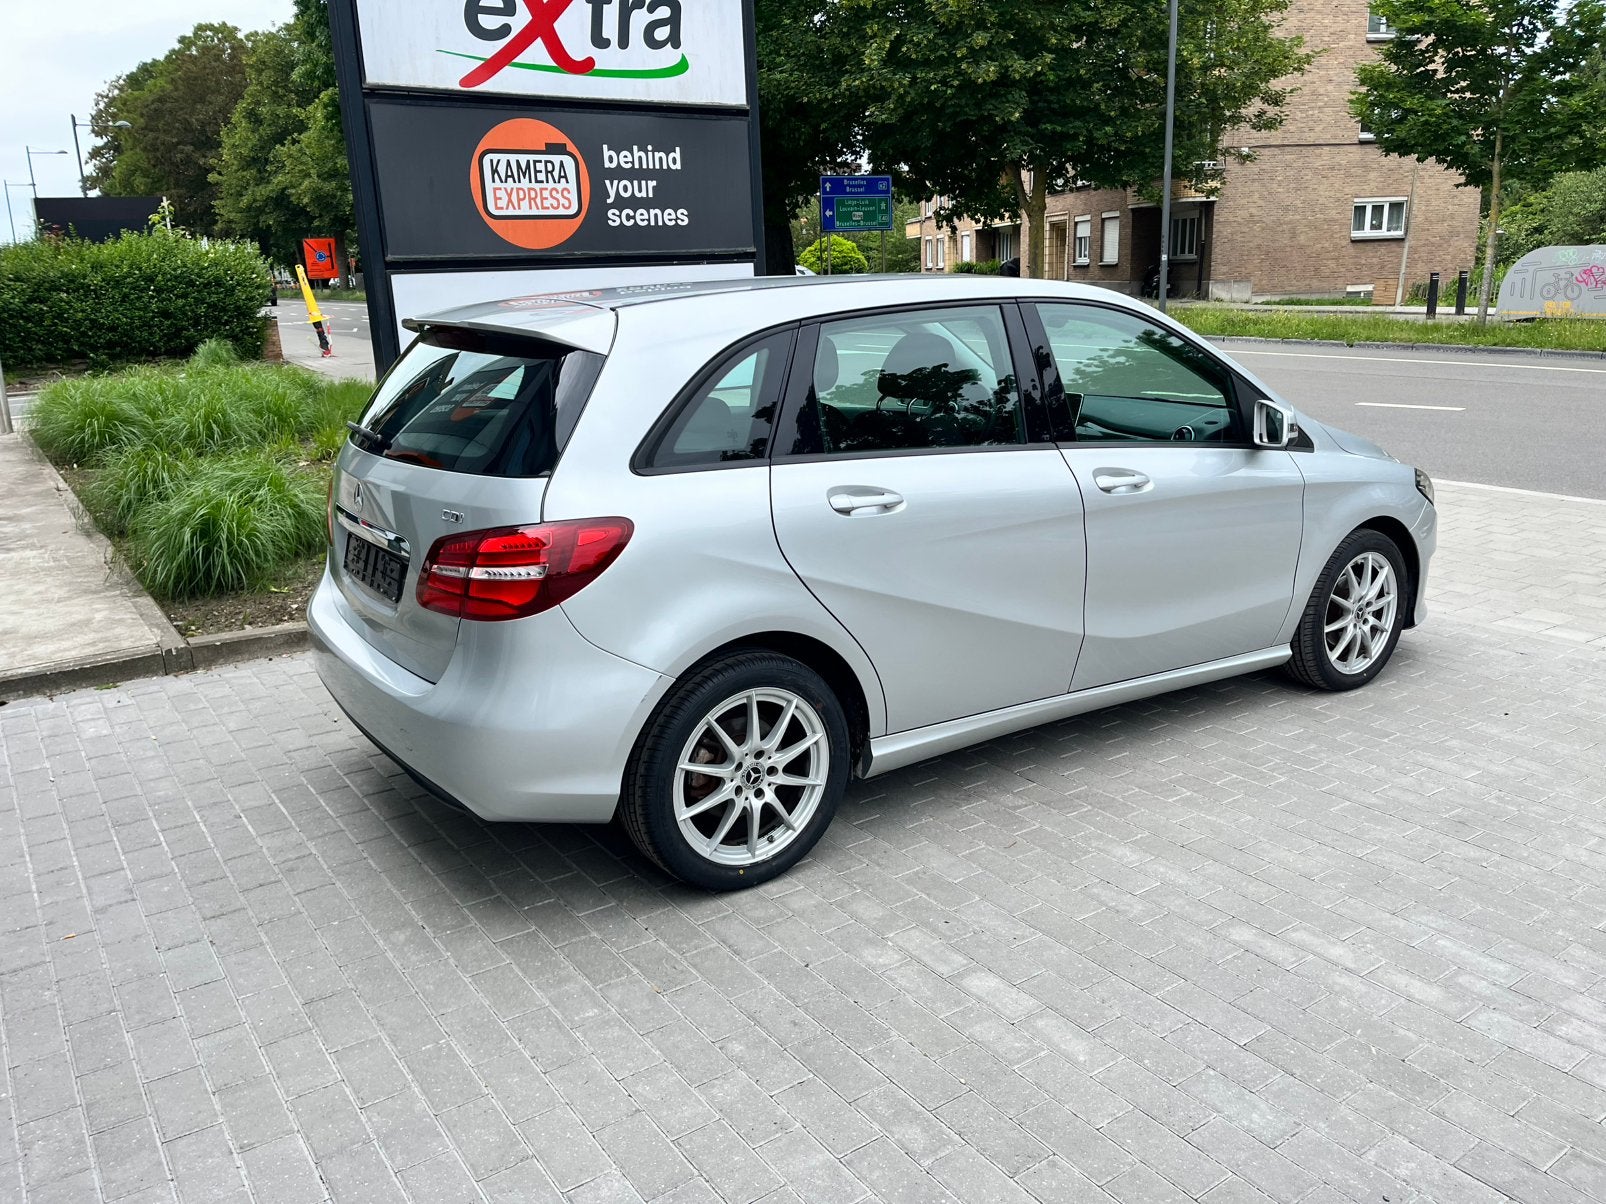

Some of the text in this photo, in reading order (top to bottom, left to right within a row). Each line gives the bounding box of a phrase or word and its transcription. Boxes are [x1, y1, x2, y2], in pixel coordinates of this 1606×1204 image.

[602, 144, 682, 170] behind
[490, 158, 570, 185] KAMERA
[493, 187, 572, 211] EXPRESS
[604, 177, 657, 204] your
[606, 207, 690, 227] scenes
